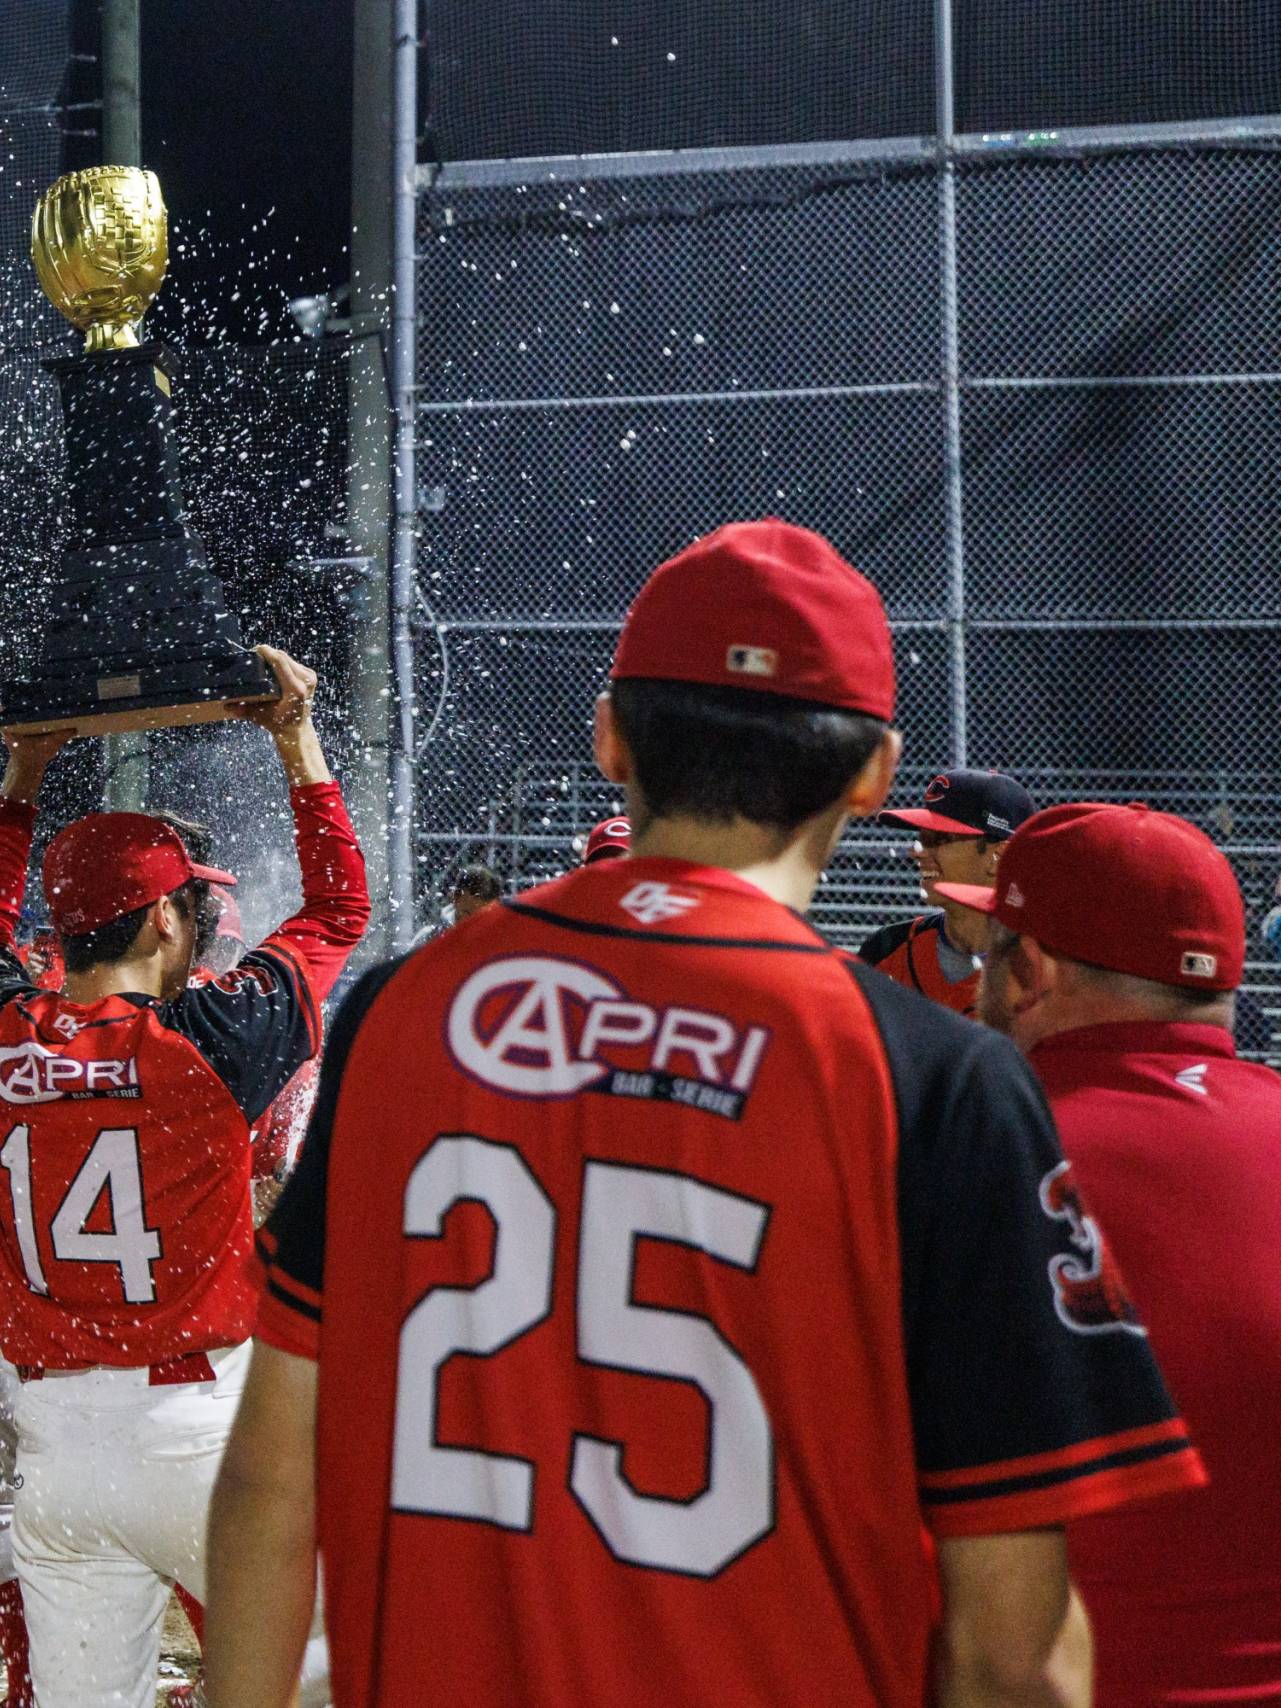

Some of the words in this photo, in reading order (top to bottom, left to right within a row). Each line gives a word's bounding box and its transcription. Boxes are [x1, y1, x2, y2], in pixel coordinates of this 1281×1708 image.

[604, 821, 632, 837] C
[925, 775, 950, 802] C
[448, 956, 768, 1096] CAPRI
[0, 1124, 163, 1304] 14
[391, 1133, 778, 1580] 25
